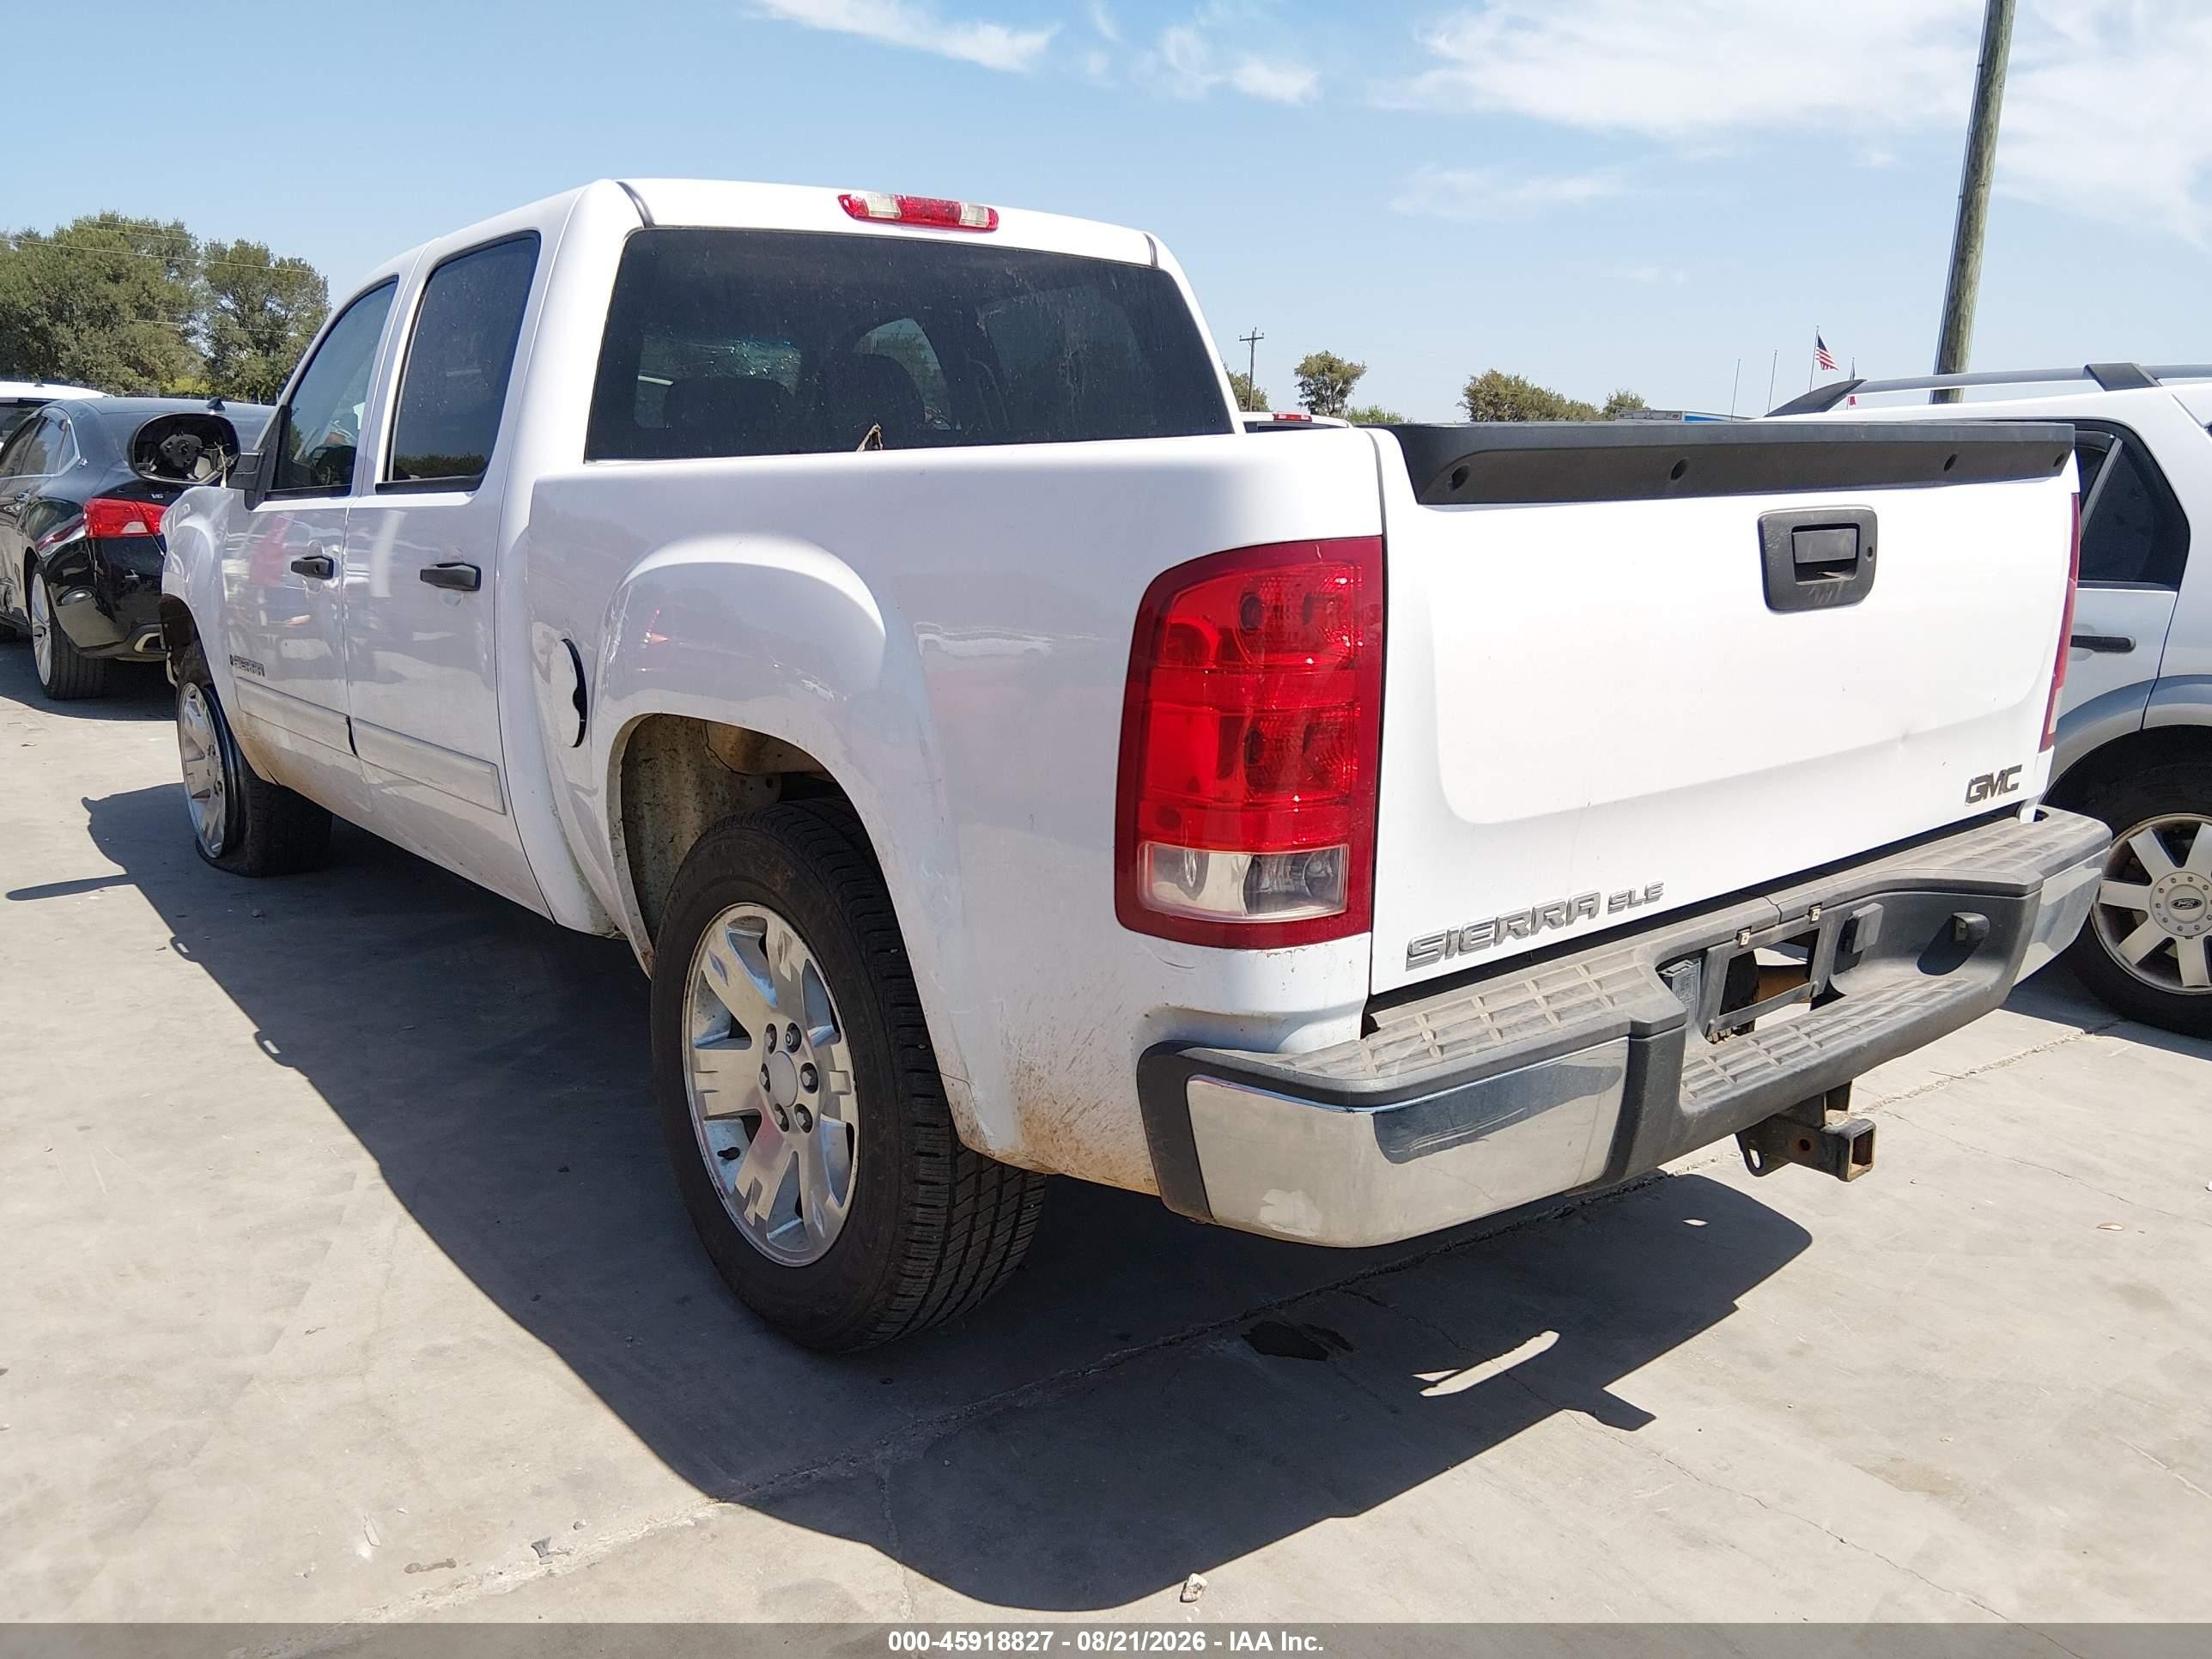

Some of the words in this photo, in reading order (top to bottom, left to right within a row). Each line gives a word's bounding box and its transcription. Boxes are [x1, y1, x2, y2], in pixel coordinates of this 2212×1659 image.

[1965, 763, 2022, 804] GMC
[1405, 888, 1601, 972] SIERRA
[1607, 881, 1664, 915] SLE
